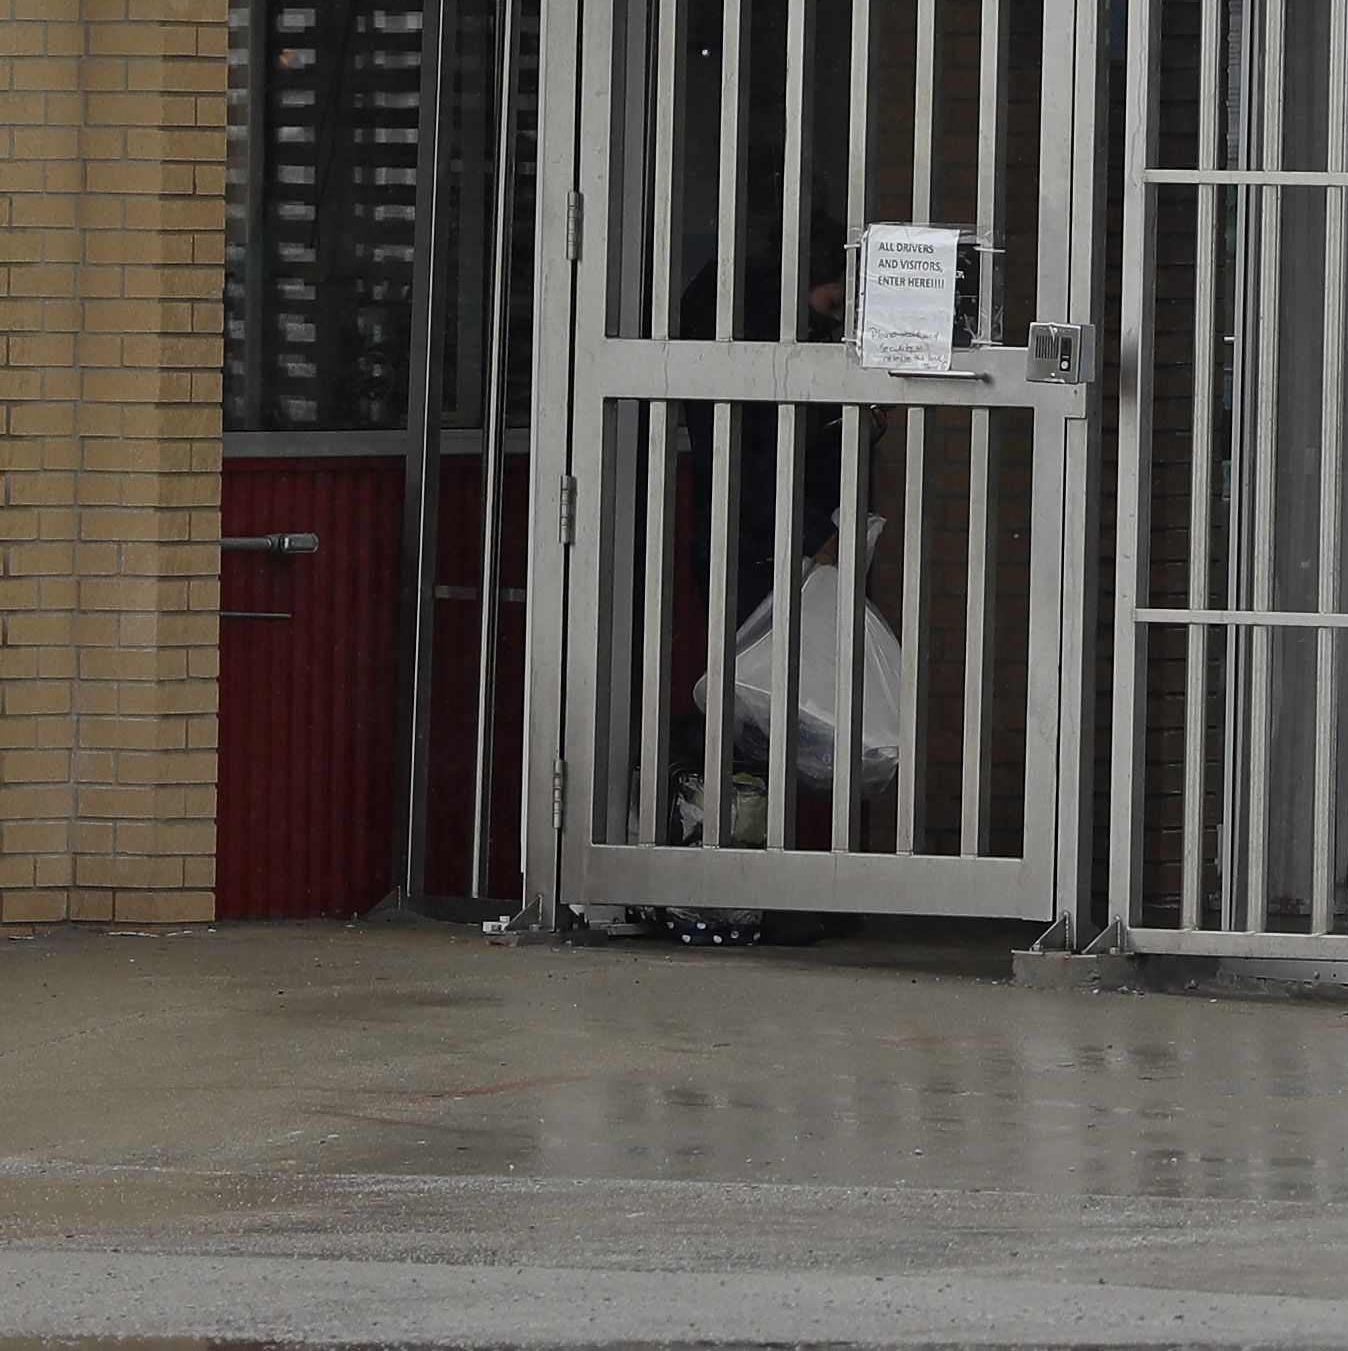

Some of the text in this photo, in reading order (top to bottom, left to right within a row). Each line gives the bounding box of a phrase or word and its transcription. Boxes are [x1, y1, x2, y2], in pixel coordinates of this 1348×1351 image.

[879, 242, 934, 254] ALL DRIVERS
[878, 259, 943, 272] AND VISITORS,
[878, 276, 905, 286] ENTER
